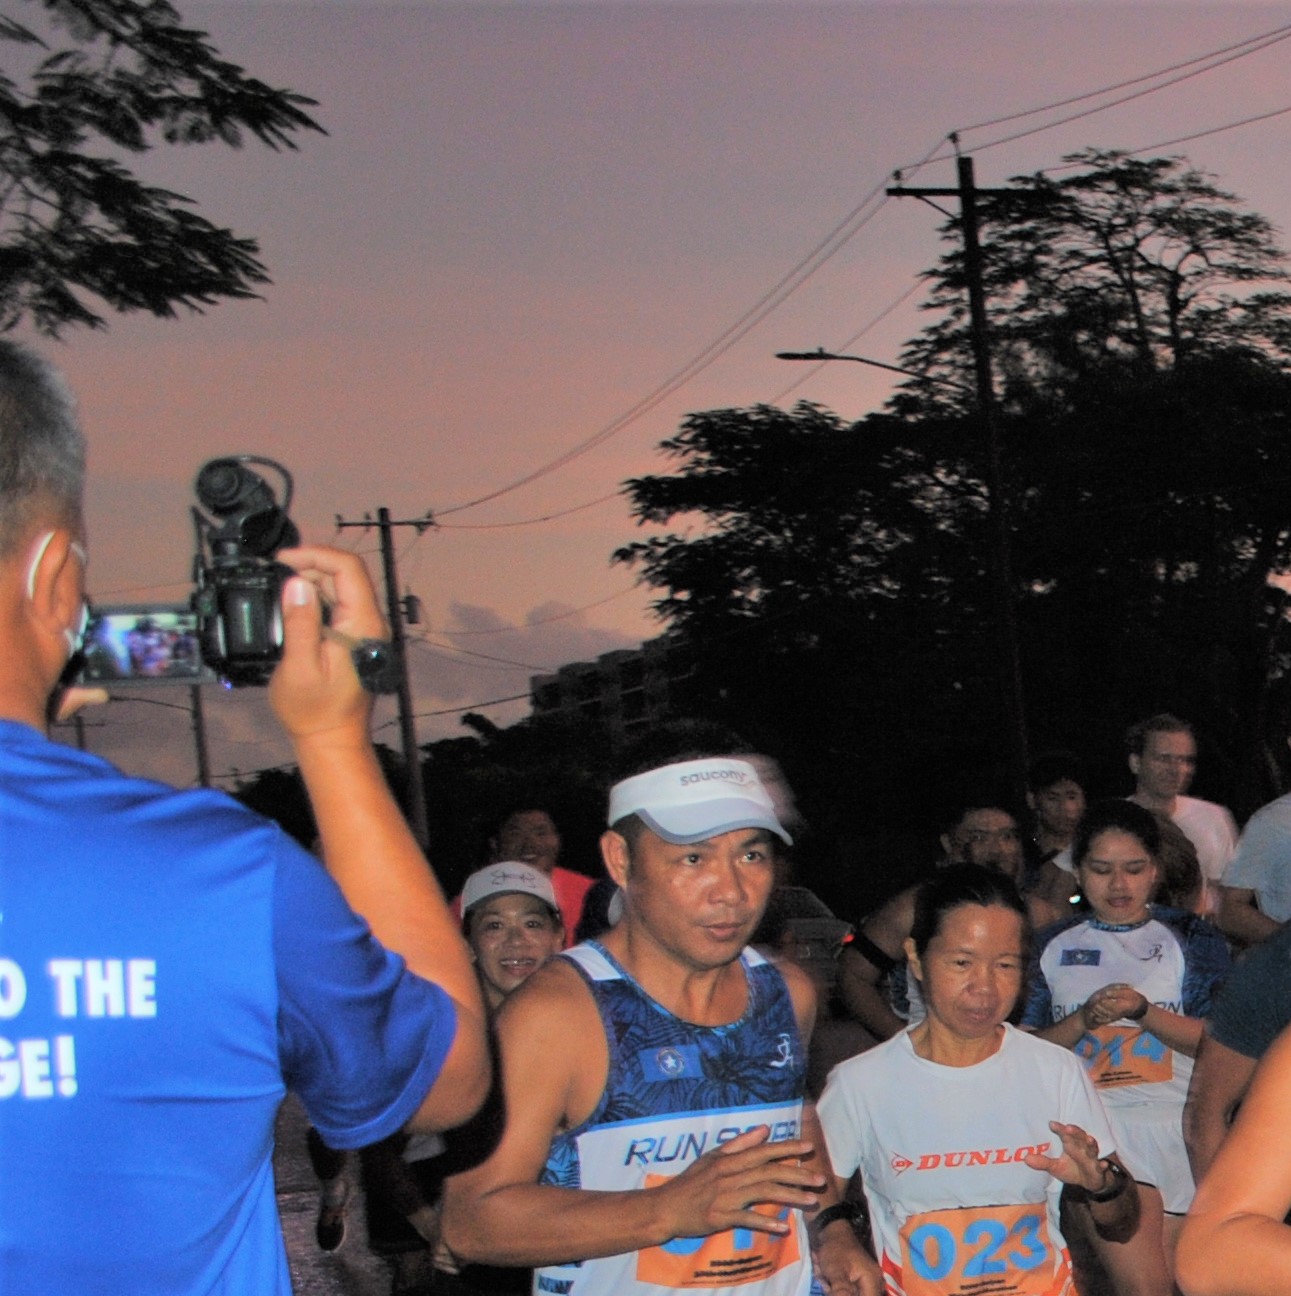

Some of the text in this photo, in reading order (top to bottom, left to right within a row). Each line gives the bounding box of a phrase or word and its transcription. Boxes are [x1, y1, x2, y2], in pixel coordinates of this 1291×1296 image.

[47, 957, 157, 1018] THE
[624, 1131, 708, 1166] RUN
[908, 1214, 1048, 1282] 023
